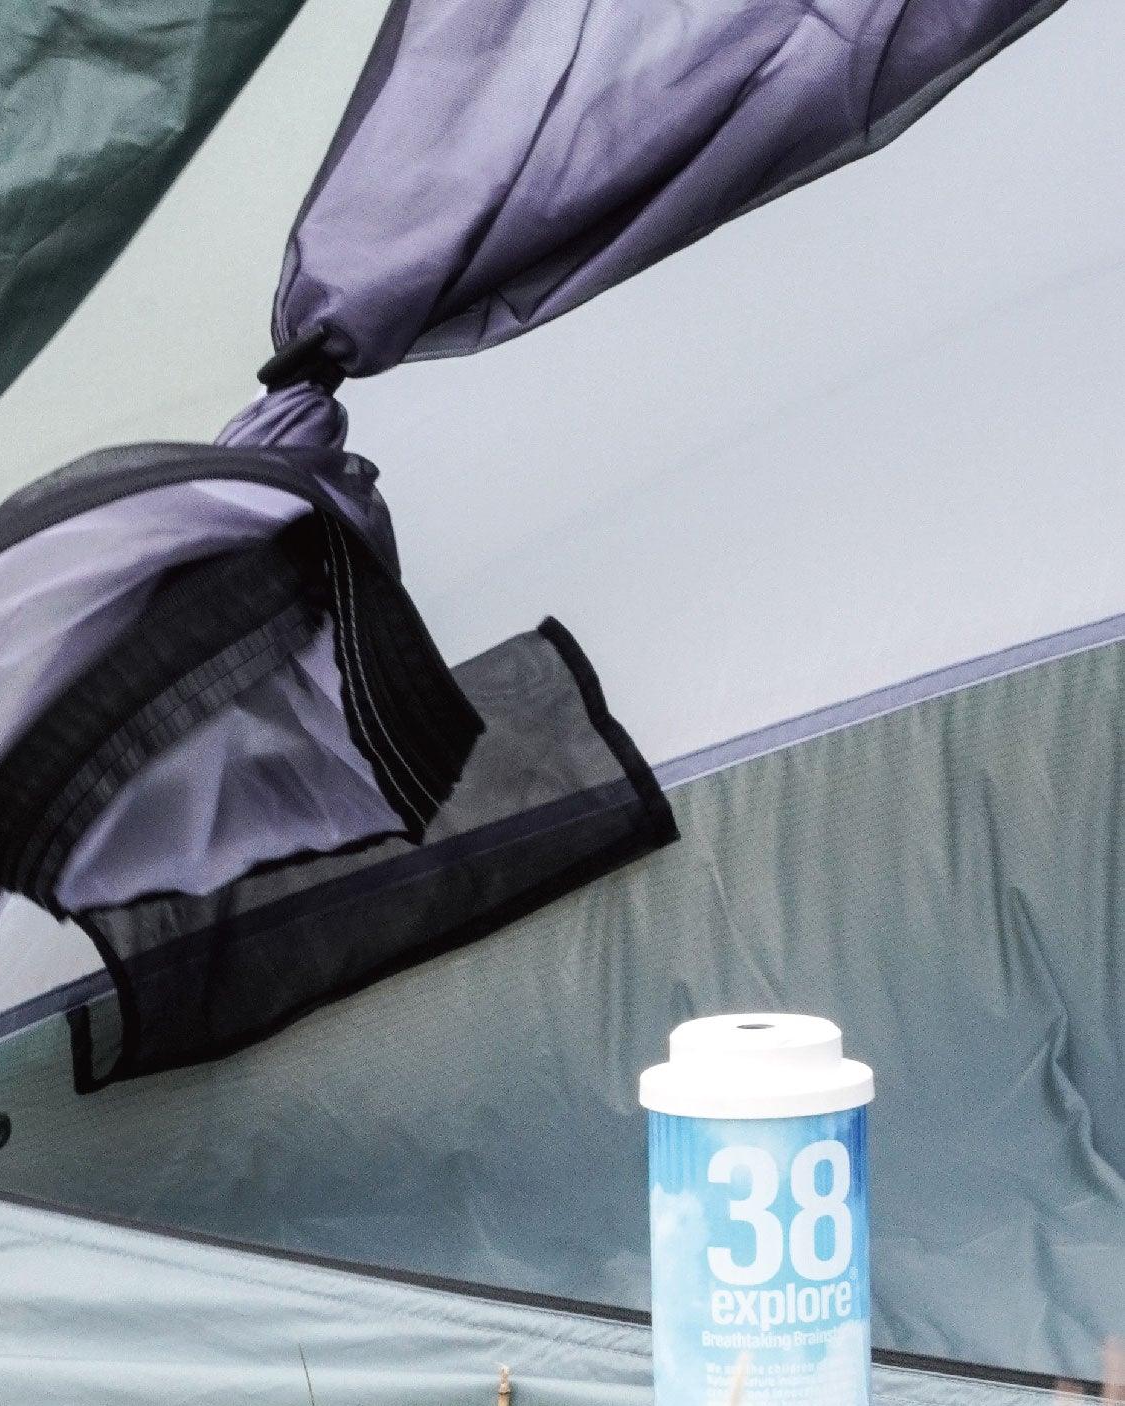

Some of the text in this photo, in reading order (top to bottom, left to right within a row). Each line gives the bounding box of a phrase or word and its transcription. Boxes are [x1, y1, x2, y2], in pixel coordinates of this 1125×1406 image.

[707, 1140, 852, 1285] 38
[711, 1281, 852, 1331] explore
[702, 1330, 792, 1350] Breathtaking
